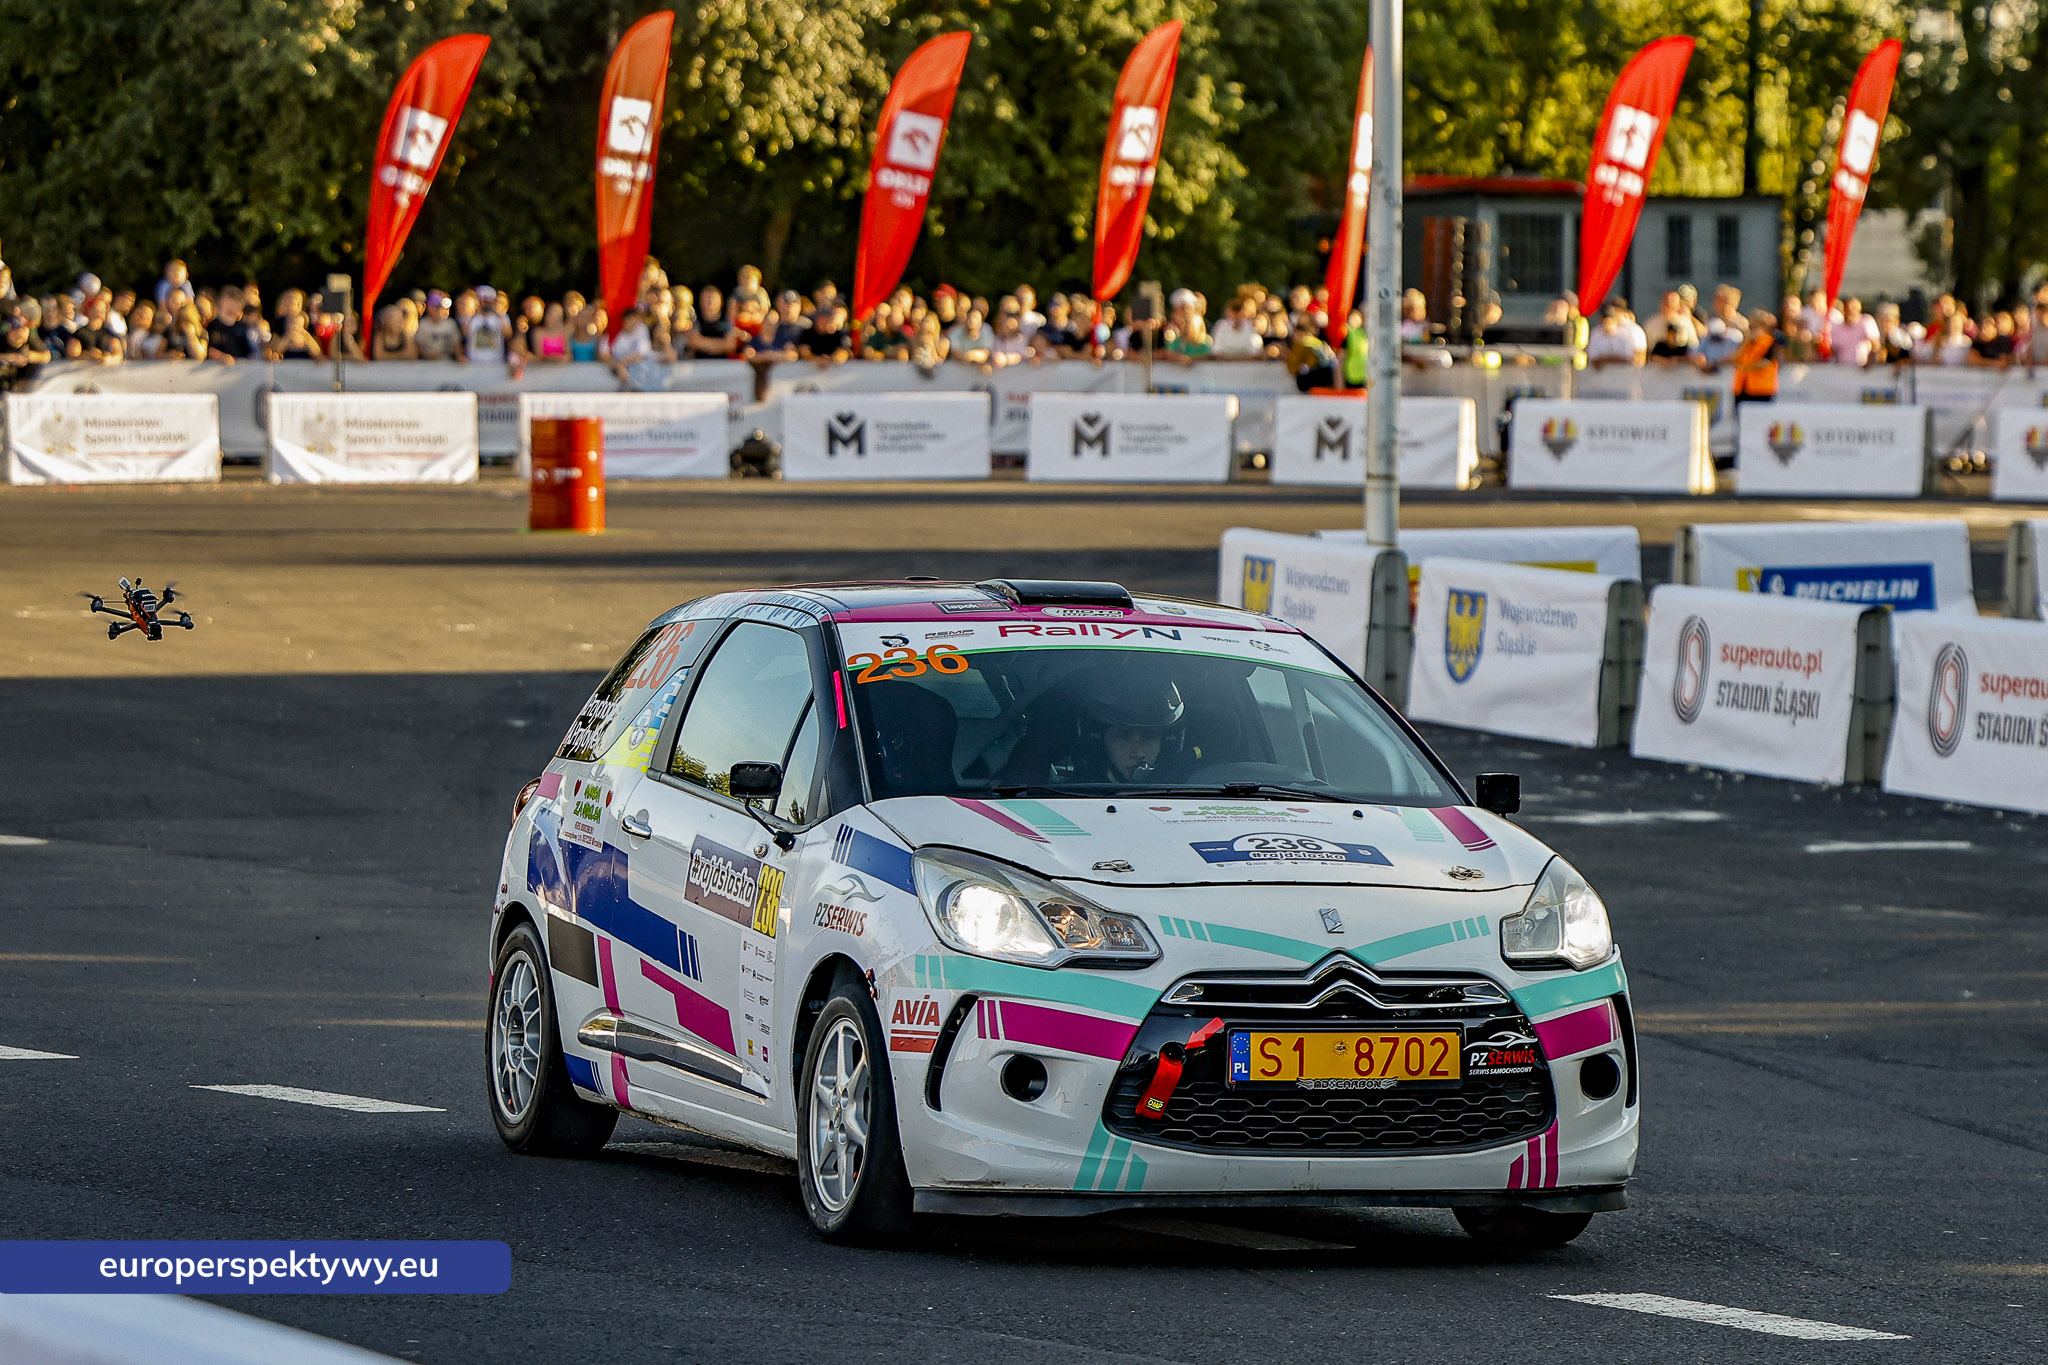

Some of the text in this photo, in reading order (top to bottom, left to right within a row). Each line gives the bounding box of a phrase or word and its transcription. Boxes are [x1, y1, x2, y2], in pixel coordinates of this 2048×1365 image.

[1794, 577, 1920, 600] MICHELIN
[848, 644, 969, 684] 236
[1720, 643, 1823, 680] superauto.pl
[1716, 680, 1821, 727] STADION ŚLĄSKI
[1977, 711, 2037, 746] STADION
[1247, 838, 1323, 851] 236
[753, 864, 785, 938] 236
[813, 902, 868, 936] PZSERWIS
[1233, 1062, 1249, 1074] PL
[1259, 1036, 1450, 1077] S1 8702
[1470, 1049, 1535, 1066] PZSERWIS
[1490, 1066, 1533, 1075] SAMOCHODOWY
